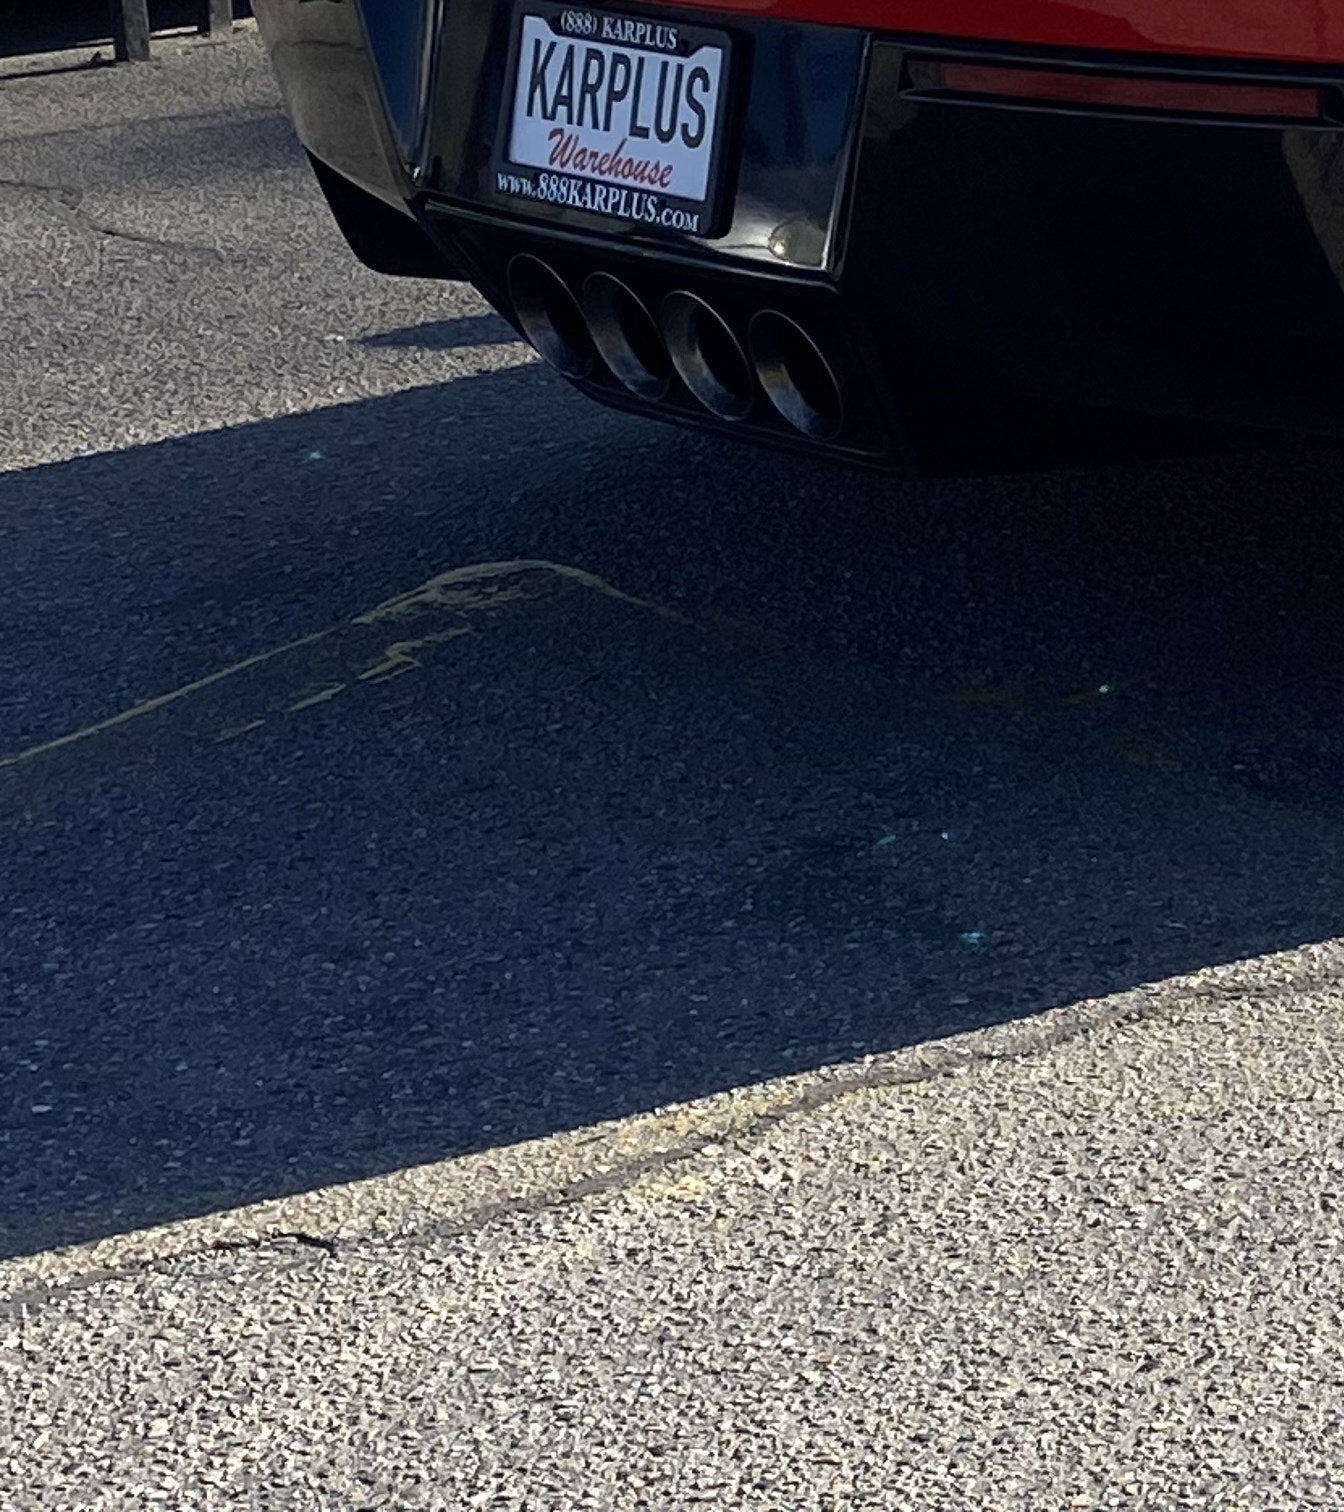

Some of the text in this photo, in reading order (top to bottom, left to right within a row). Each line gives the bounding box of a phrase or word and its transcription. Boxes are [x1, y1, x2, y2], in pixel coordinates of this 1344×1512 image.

[560, 10, 678, 50] (888) KARPLUS
[526, 38, 711, 149] KARPLUS
[547, 128, 674, 188] Warehouse
